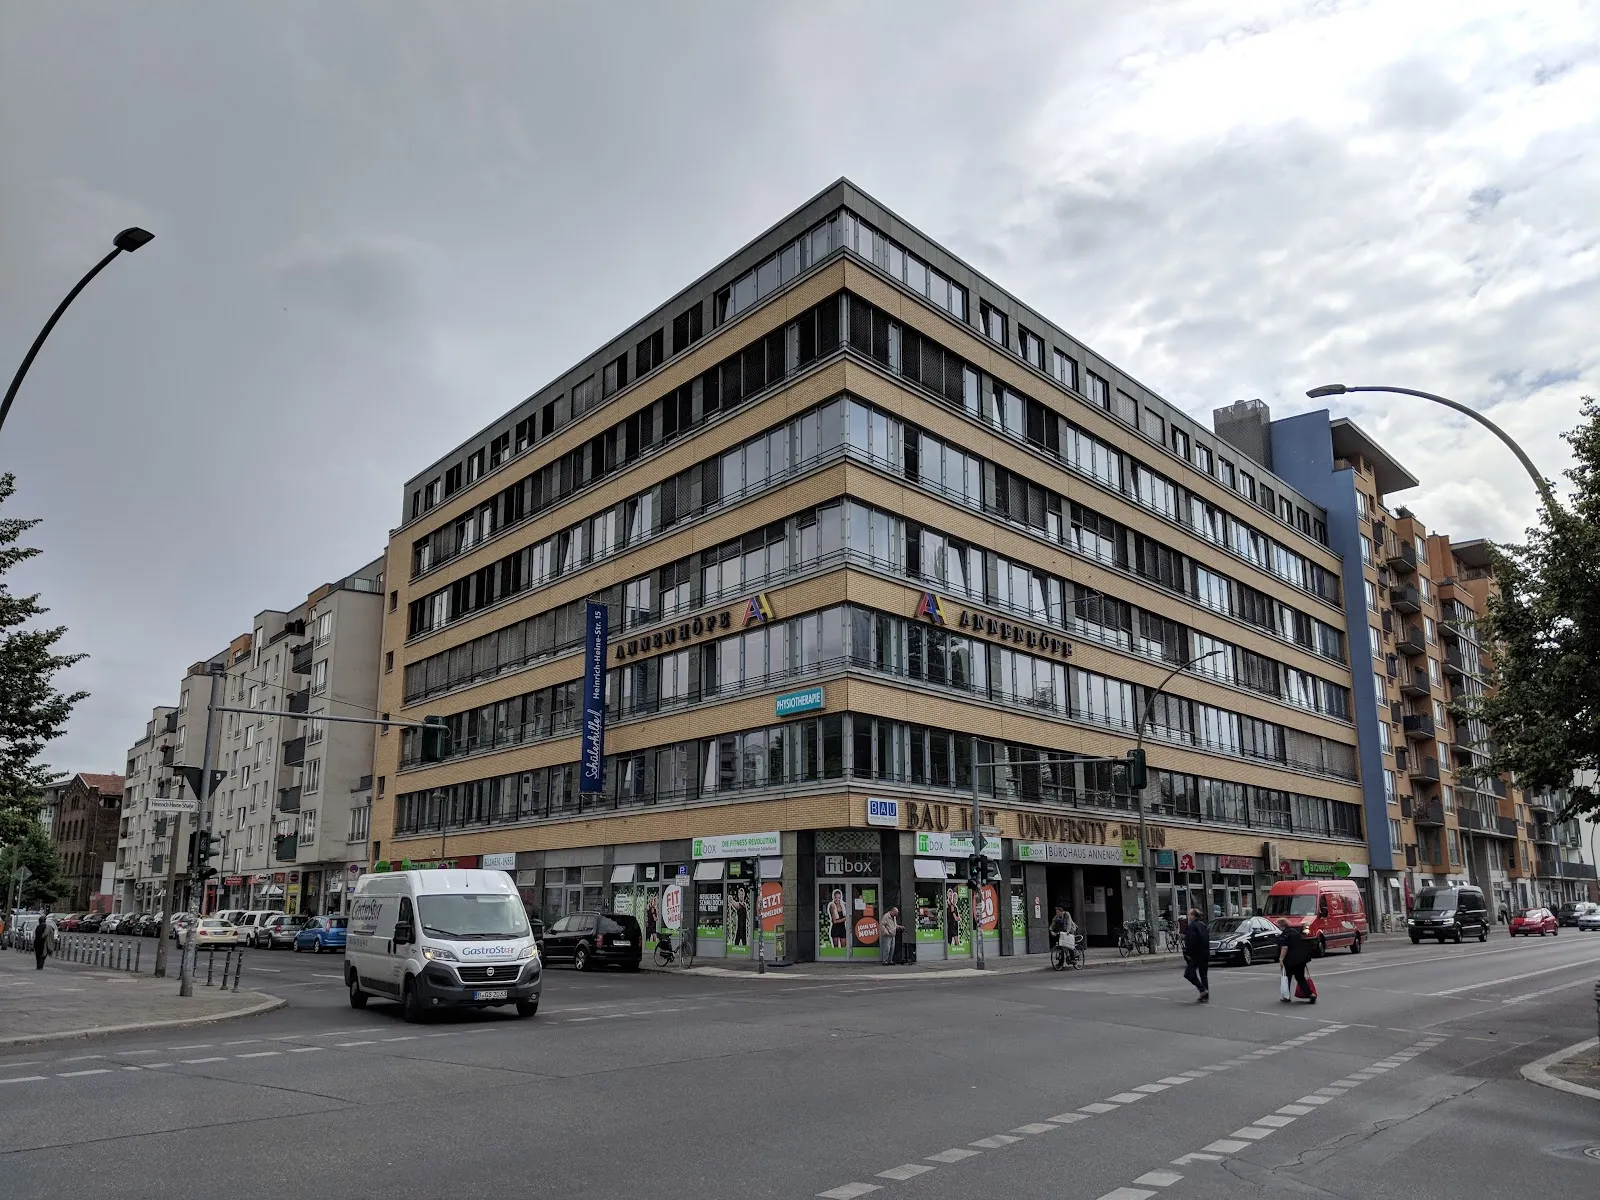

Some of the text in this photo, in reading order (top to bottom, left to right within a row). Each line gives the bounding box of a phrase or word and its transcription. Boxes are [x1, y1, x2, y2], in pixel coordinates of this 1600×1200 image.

[615, 611, 730, 659] ANNENHÖFE
[960, 610, 1072, 657] ANNENHÖFE
[592, 610, 602, 700] Heinrich-Heine-Str. 15
[775, 690, 822, 711] PHYSIOTHERAPIE
[871, 801, 897, 816] BAU
[905, 801, 950, 831] BAU
[1016, 813, 1108, 845] UNIVERSITY
[721, 836, 777, 848] DIE FITNESS REVOLUTION
[1049, 845, 1087, 860] BÜROHAUS
[825, 856, 873, 874] fitbox
[666, 889, 680, 908] FIT
[761, 893, 782, 909] ETZT
[667, 906, 680, 916] STATT
[857, 922, 877, 932] JOIN US
[858, 928, 879, 938] NOW!
[462, 946, 515, 956] GastroStar
